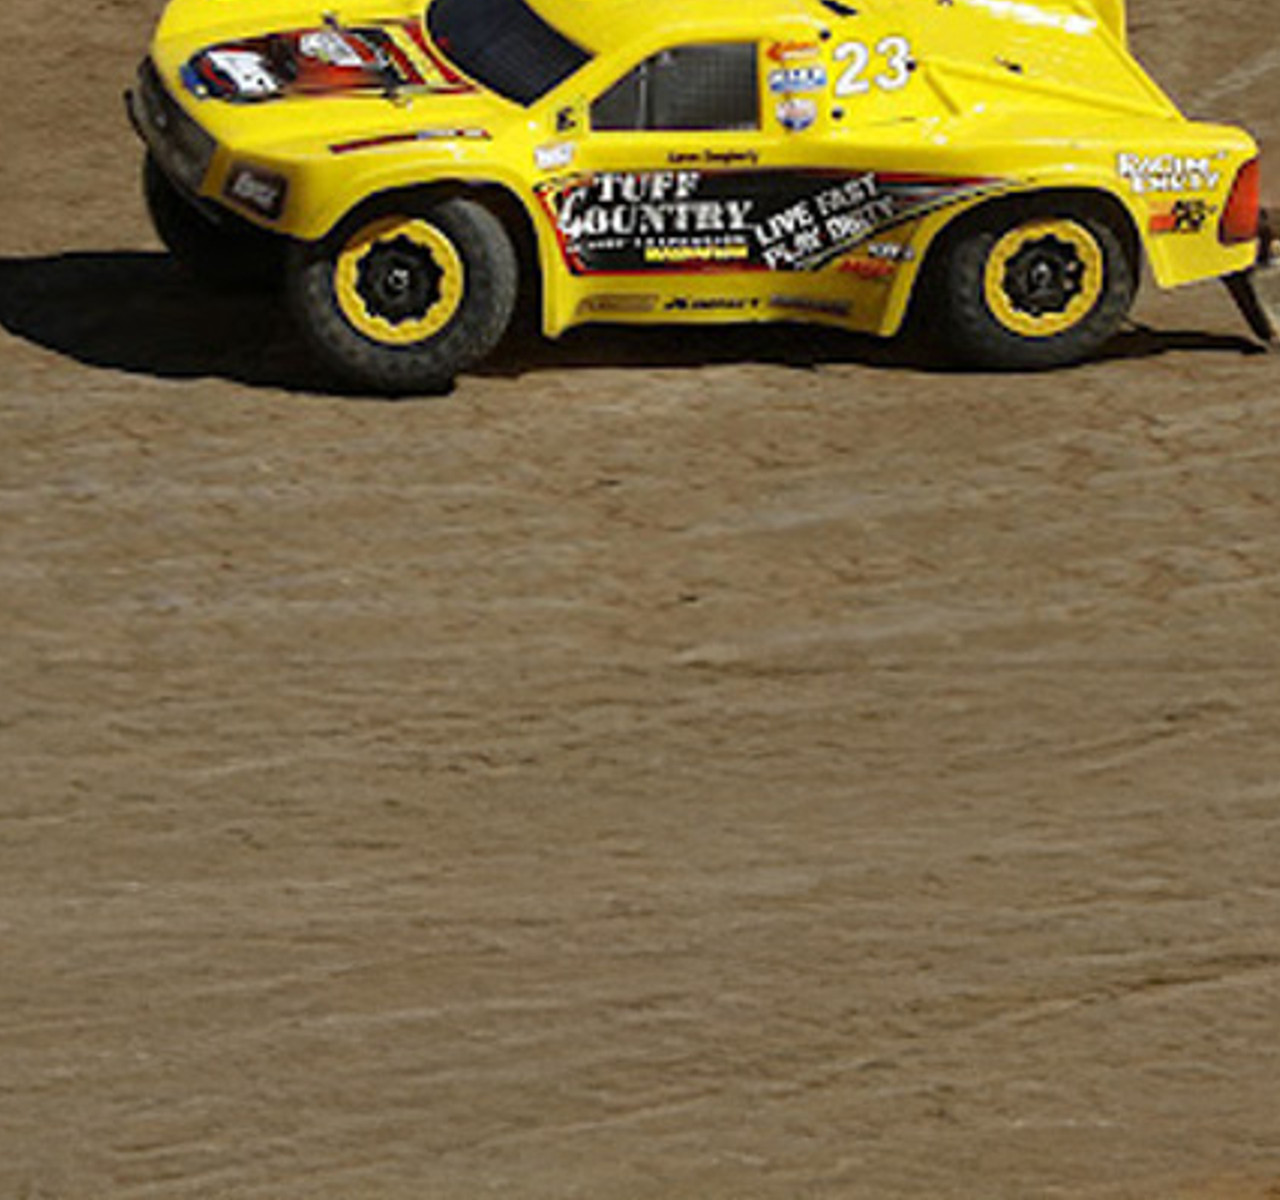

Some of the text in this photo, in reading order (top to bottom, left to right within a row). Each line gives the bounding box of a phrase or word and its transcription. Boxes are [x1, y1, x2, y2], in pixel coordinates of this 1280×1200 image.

[834, 36, 910, 97] 23
[558, 186, 757, 238] COUNTRY
[597, 172, 701, 201] TUFF
[755, 172, 878, 246] LIVE FAST
[762, 225, 822, 270] PLAY
[826, 195, 894, 241] DIRTY
